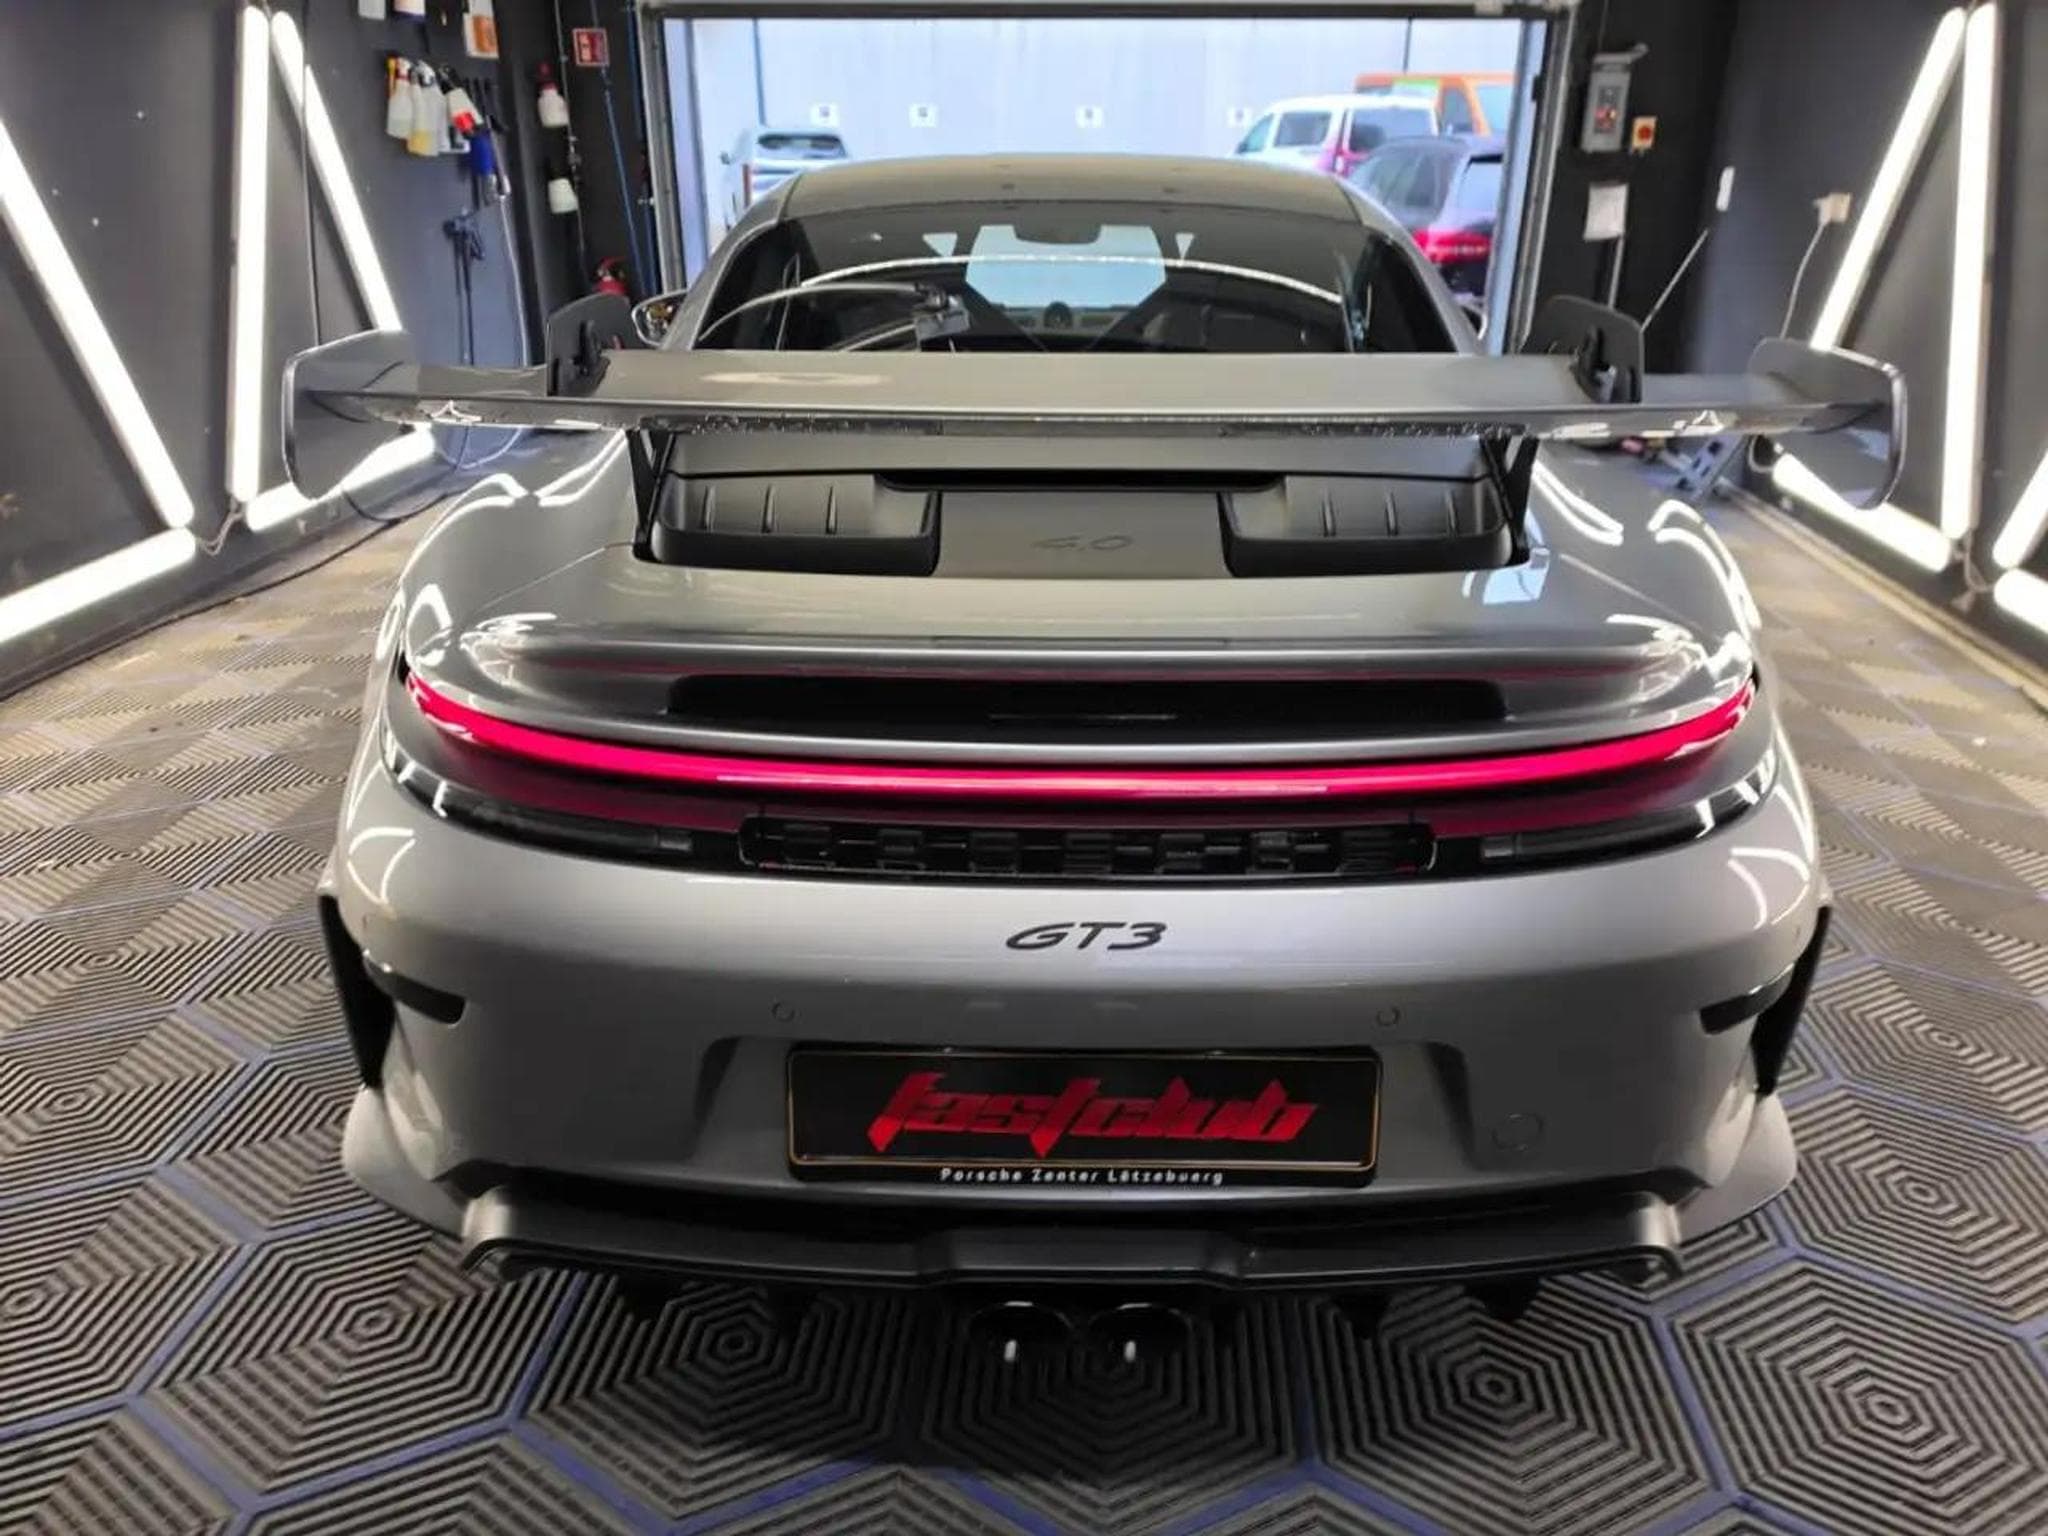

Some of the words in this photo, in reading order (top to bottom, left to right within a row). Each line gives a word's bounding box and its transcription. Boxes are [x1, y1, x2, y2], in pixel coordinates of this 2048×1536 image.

[1005, 922, 1168, 951] GT3
[939, 1167, 1023, 1183] Porsche
[1031, 1168, 1099, 1183] Zenter
